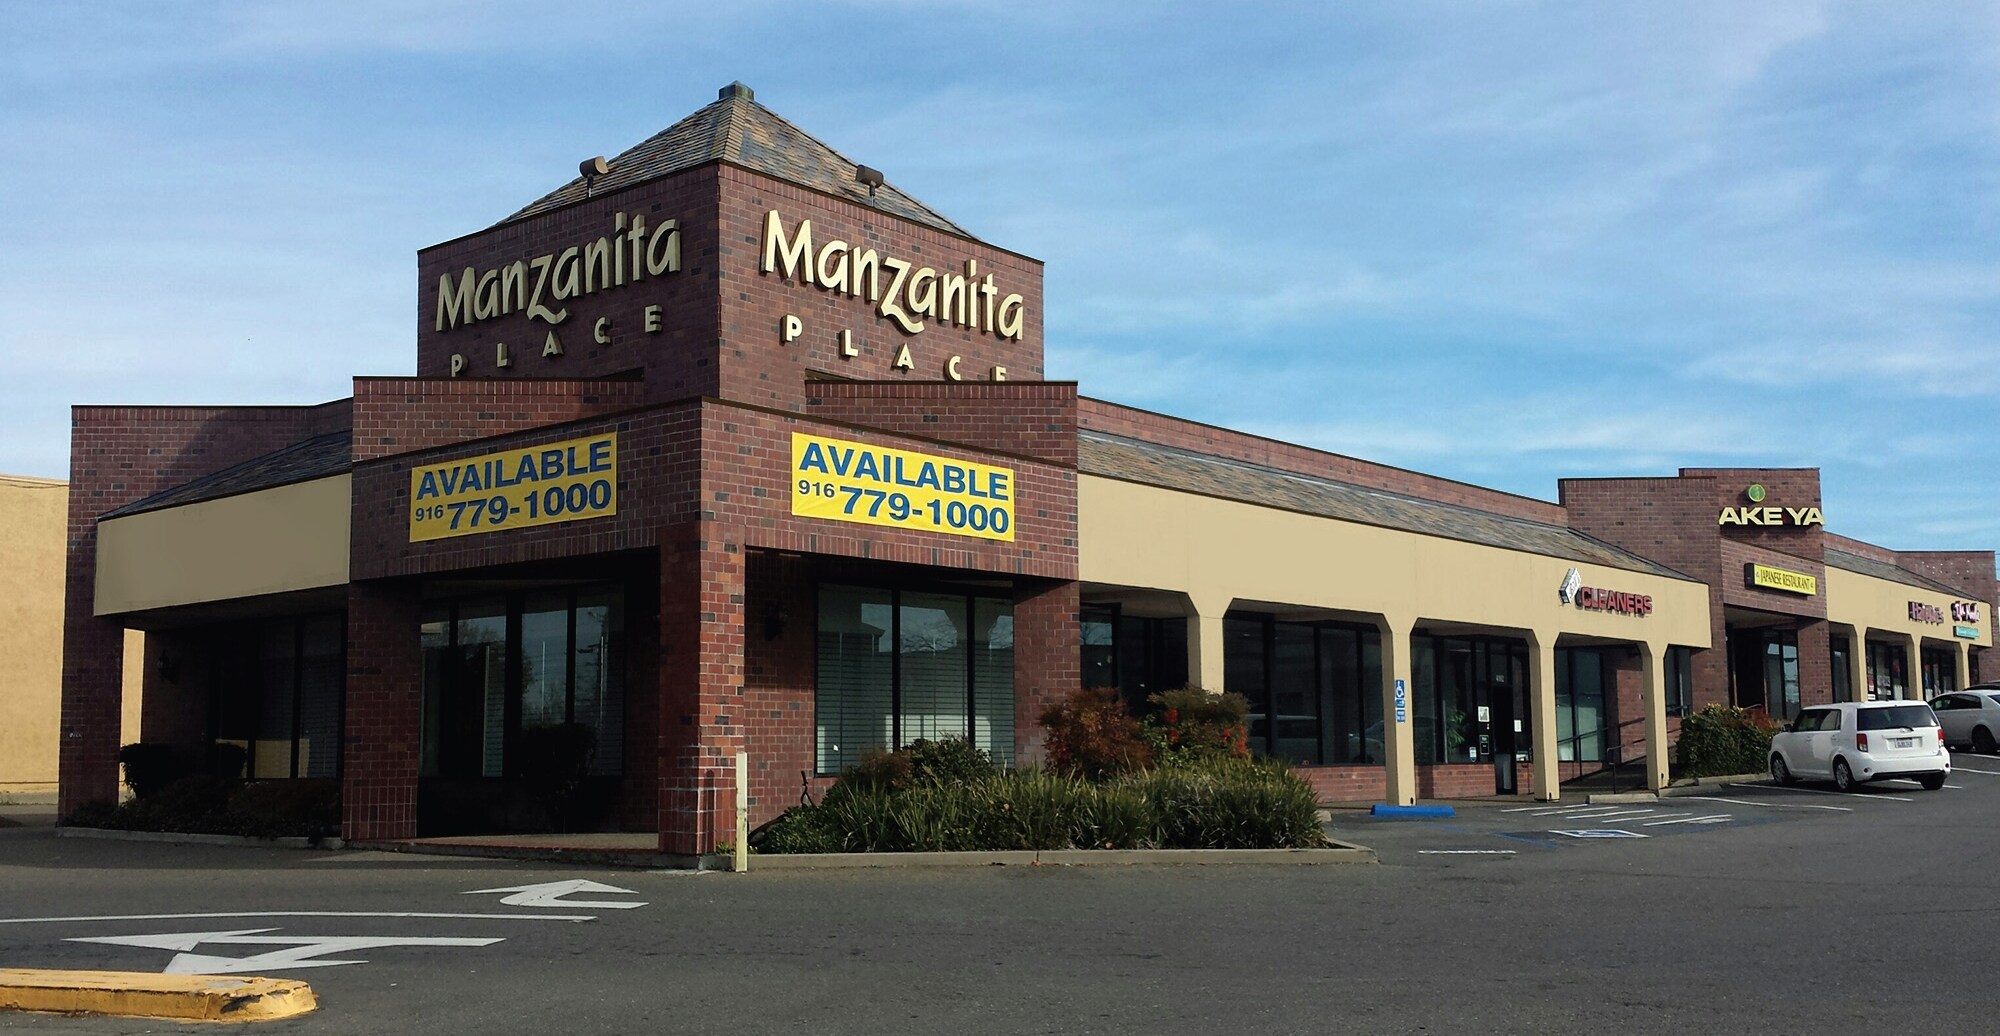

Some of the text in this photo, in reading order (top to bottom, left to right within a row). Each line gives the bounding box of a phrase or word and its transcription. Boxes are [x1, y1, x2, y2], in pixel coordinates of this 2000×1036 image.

[435, 211, 682, 332] Manzanita
[760, 209, 1024, 341] Manzanita
[451, 304, 663, 378] PLACE
[416, 440, 612, 500] AVAILABLE
[799, 442, 1009, 501] AVAILABLE
[415, 479, 612, 530] 916 779-1000
[798, 480, 1009, 533] 916 779-1000
[1580, 587, 1653, 615] CLEANERS
[1760, 569, 1809, 590] JAPANESE RESTAURANT
